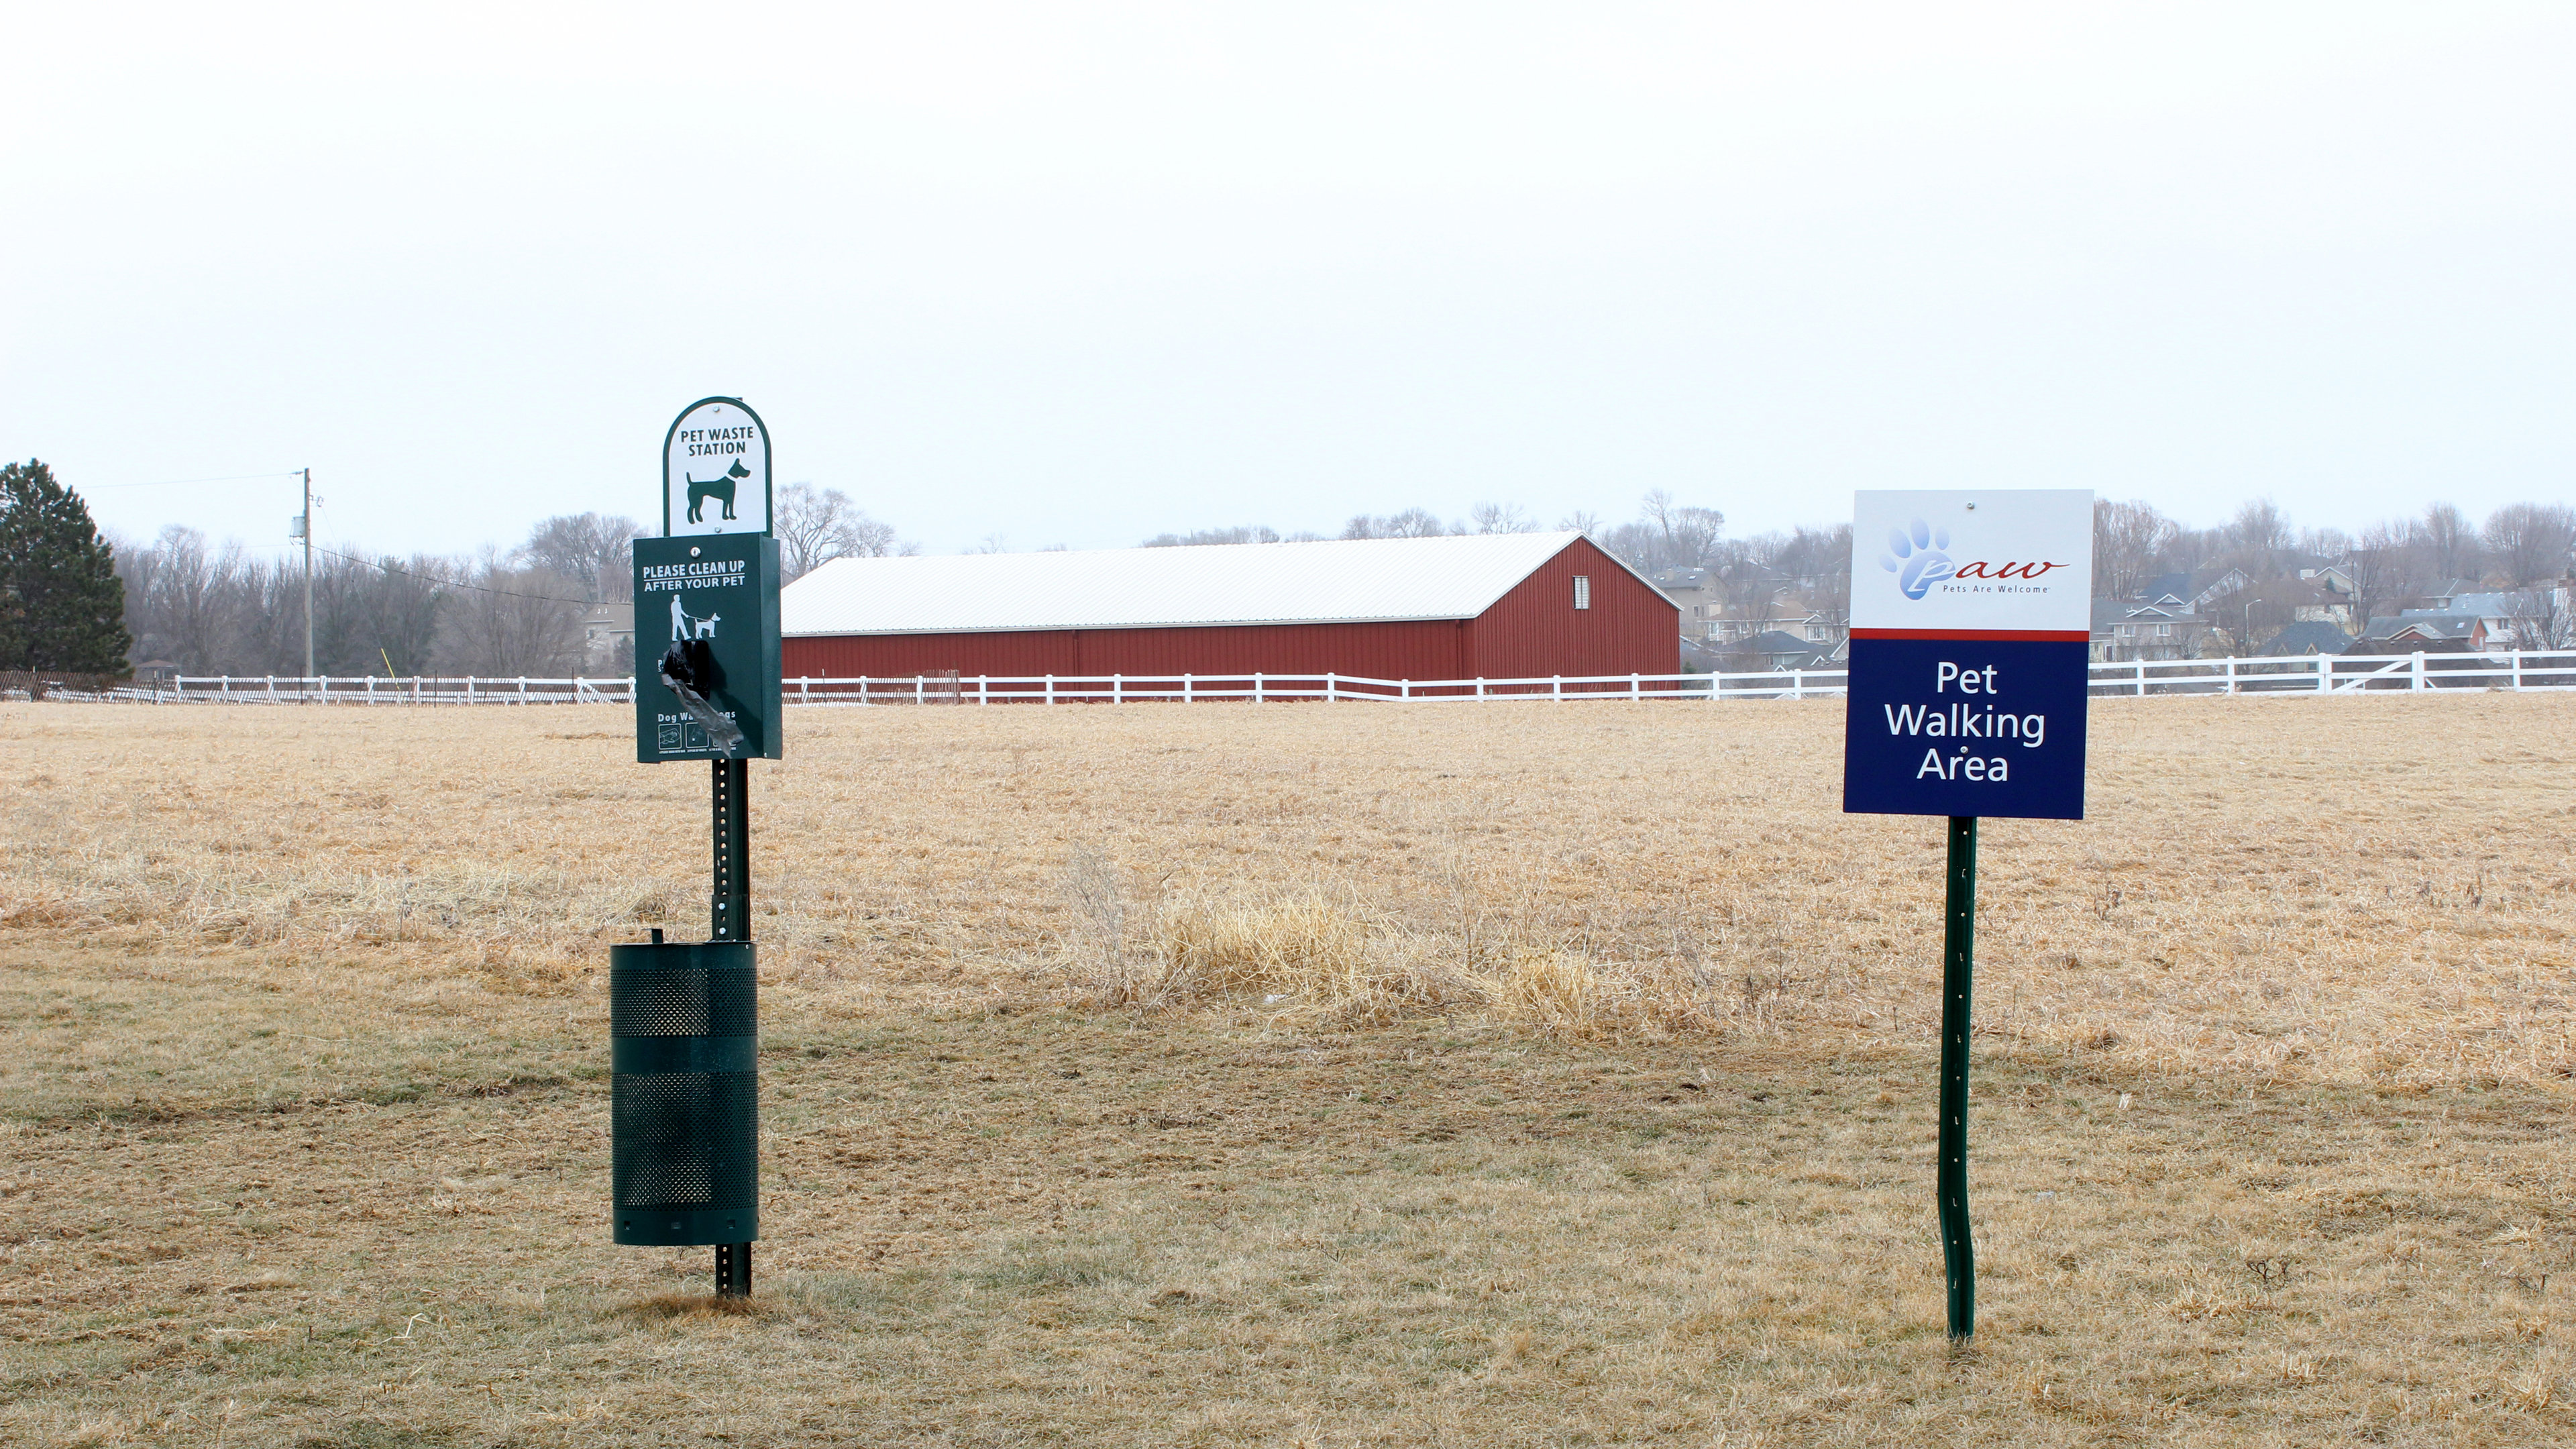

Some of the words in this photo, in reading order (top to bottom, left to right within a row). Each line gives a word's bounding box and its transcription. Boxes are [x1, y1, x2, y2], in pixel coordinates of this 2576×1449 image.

[681, 430, 704, 443] PET
[708, 427, 753, 441] WASTE
[689, 441, 746, 457] STATION
[643, 564, 686, 579] PLEASE
[688, 561, 726, 575] CLEAN
[729, 560, 745, 572] UP
[644, 580, 682, 592] AFTER
[685, 578, 719, 589] YOUR
[722, 576, 745, 586] PET
[1943, 585, 1967, 593] Pets
[1973, 585, 1992, 593] Are
[1937, 661, 1998, 694] Pet
[657, 713, 677, 723] Dog
[1884, 703, 2045, 748] Walking
[1917, 748, 2008, 782] Area
